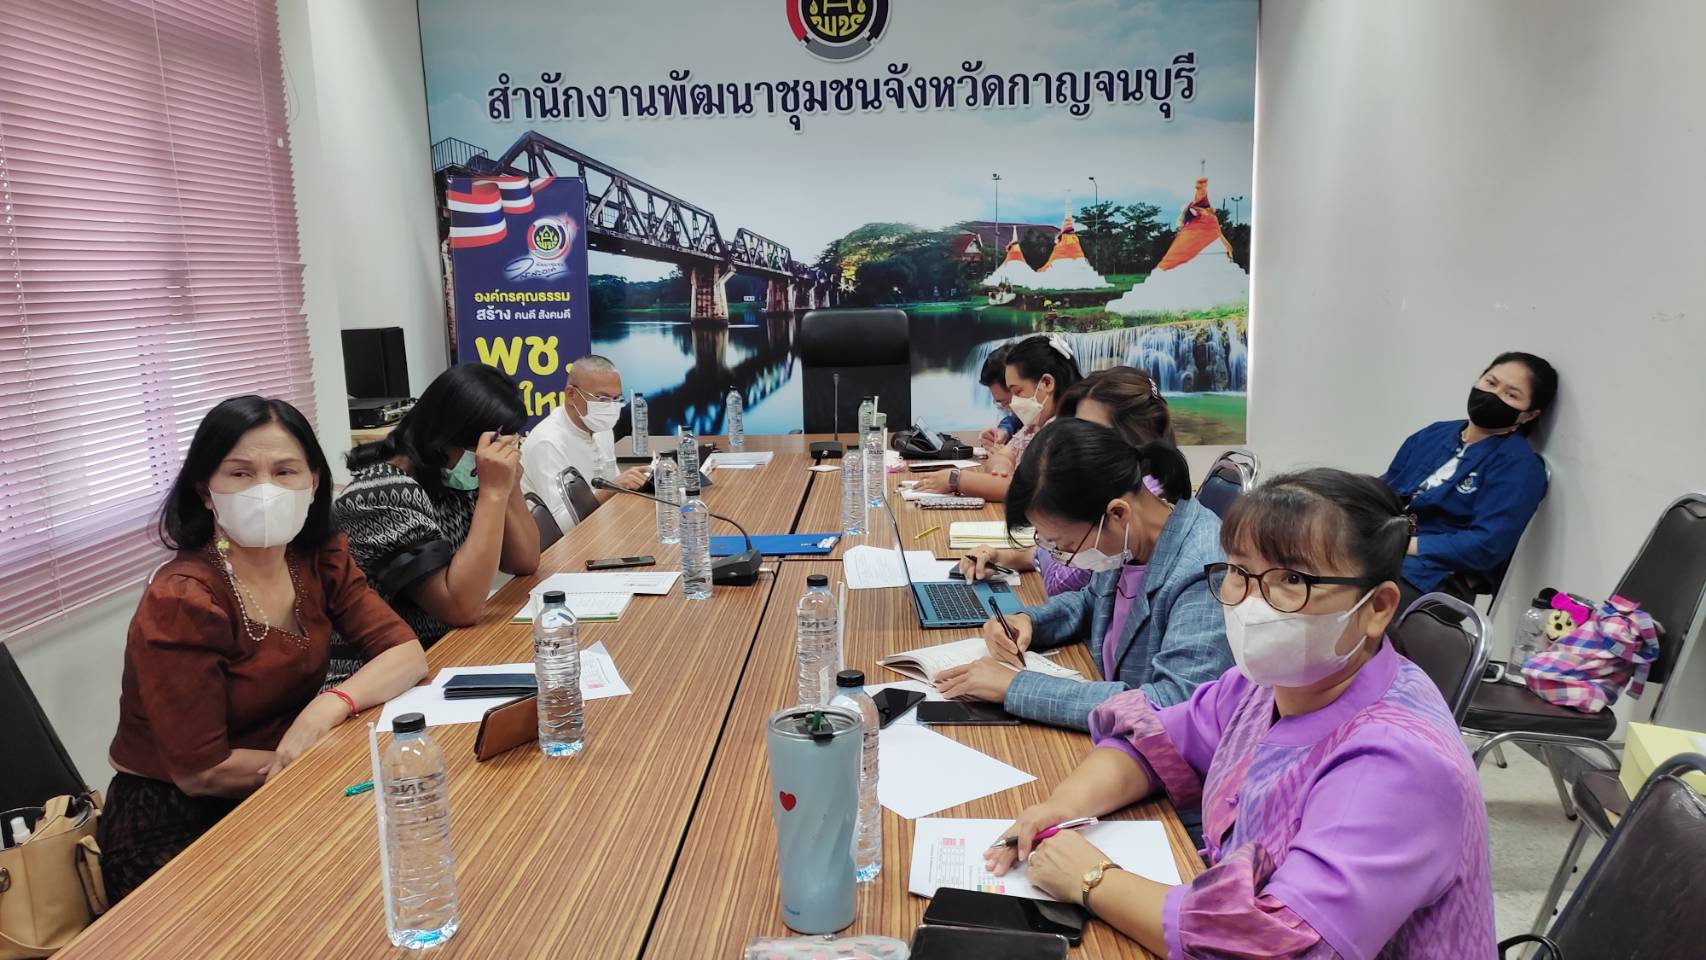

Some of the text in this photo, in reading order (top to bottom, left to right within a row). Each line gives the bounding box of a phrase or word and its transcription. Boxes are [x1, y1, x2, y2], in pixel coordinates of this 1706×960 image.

[487, 51, 1197, 131] สำนักงานพัฒนาชุมชนจังหวัดกาญจนบุรี
[474, 288, 571, 306] องค์กรคุณธรรม
[476, 304, 572, 321] สร้าง คนดี สังคมดี
